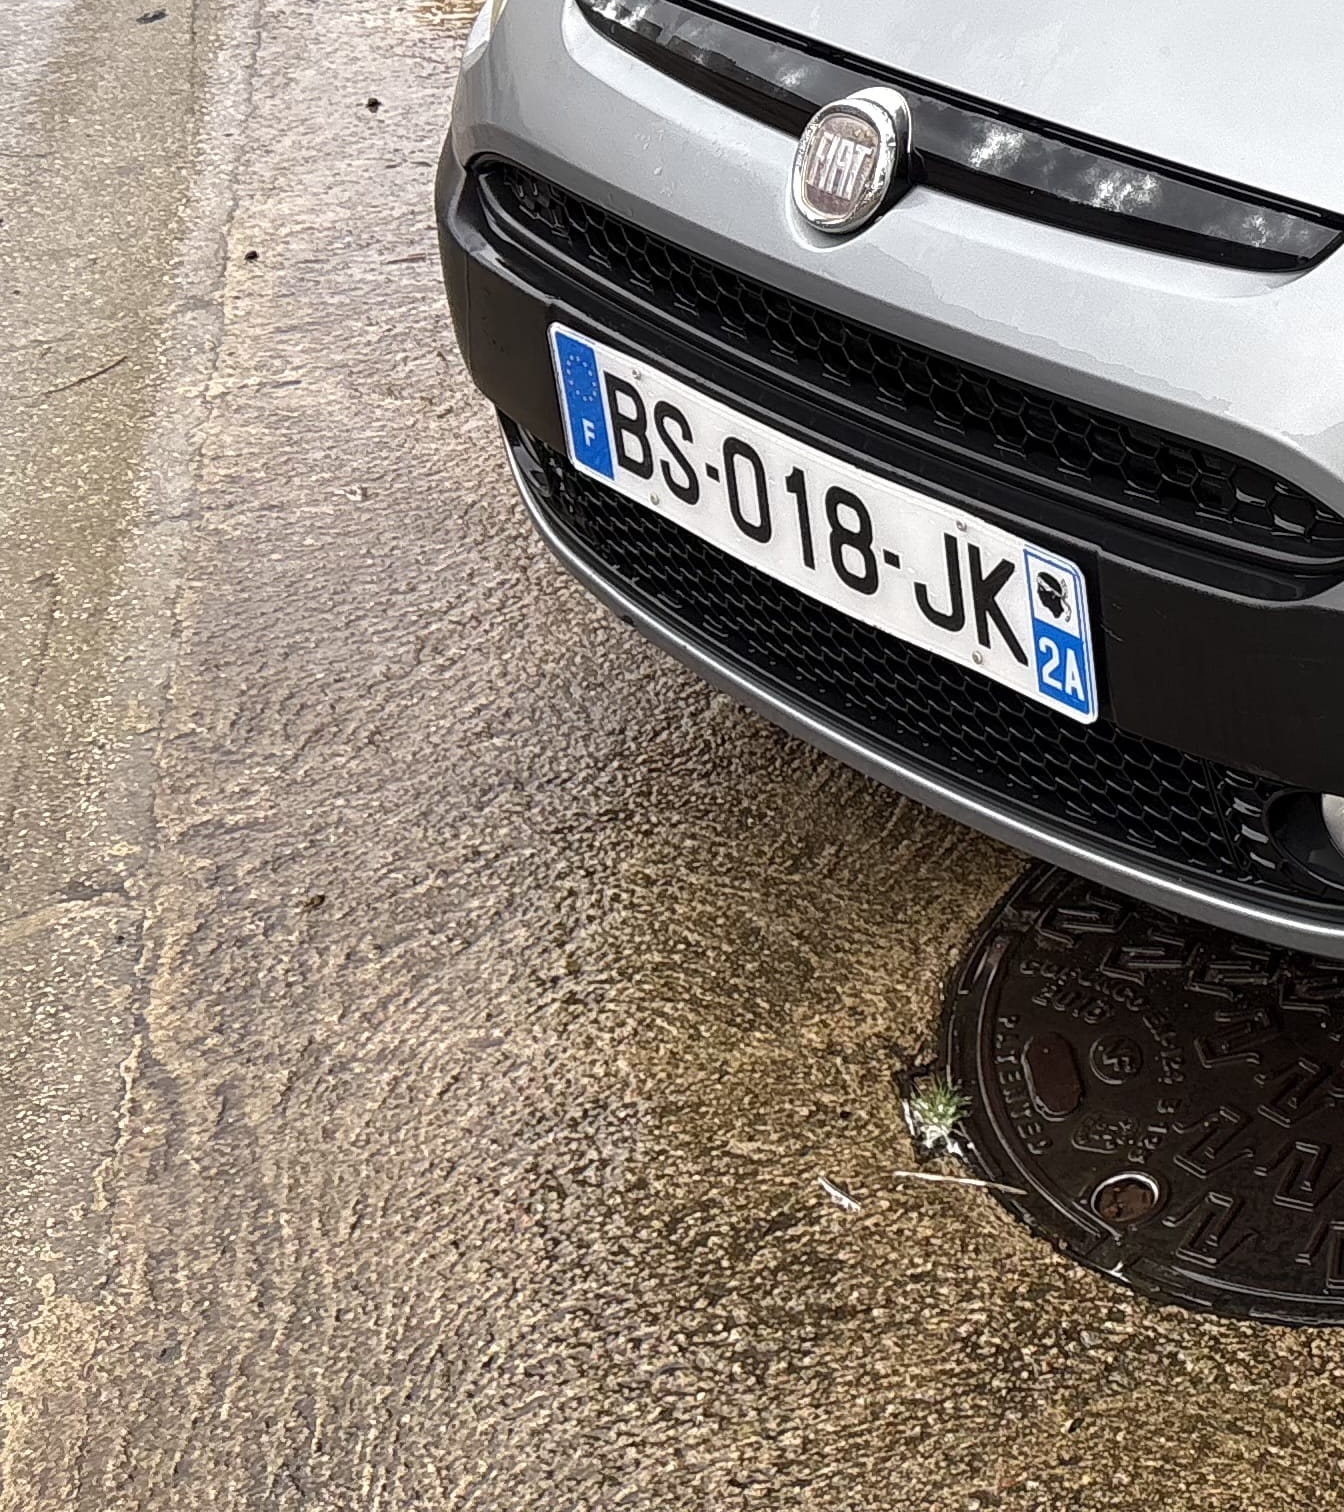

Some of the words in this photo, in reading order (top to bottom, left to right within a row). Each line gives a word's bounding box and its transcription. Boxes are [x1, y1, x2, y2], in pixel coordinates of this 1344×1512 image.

[806, 131, 874, 201] FIAT
[581, 418, 596, 447] F
[1040, 639, 1084, 700] 2A
